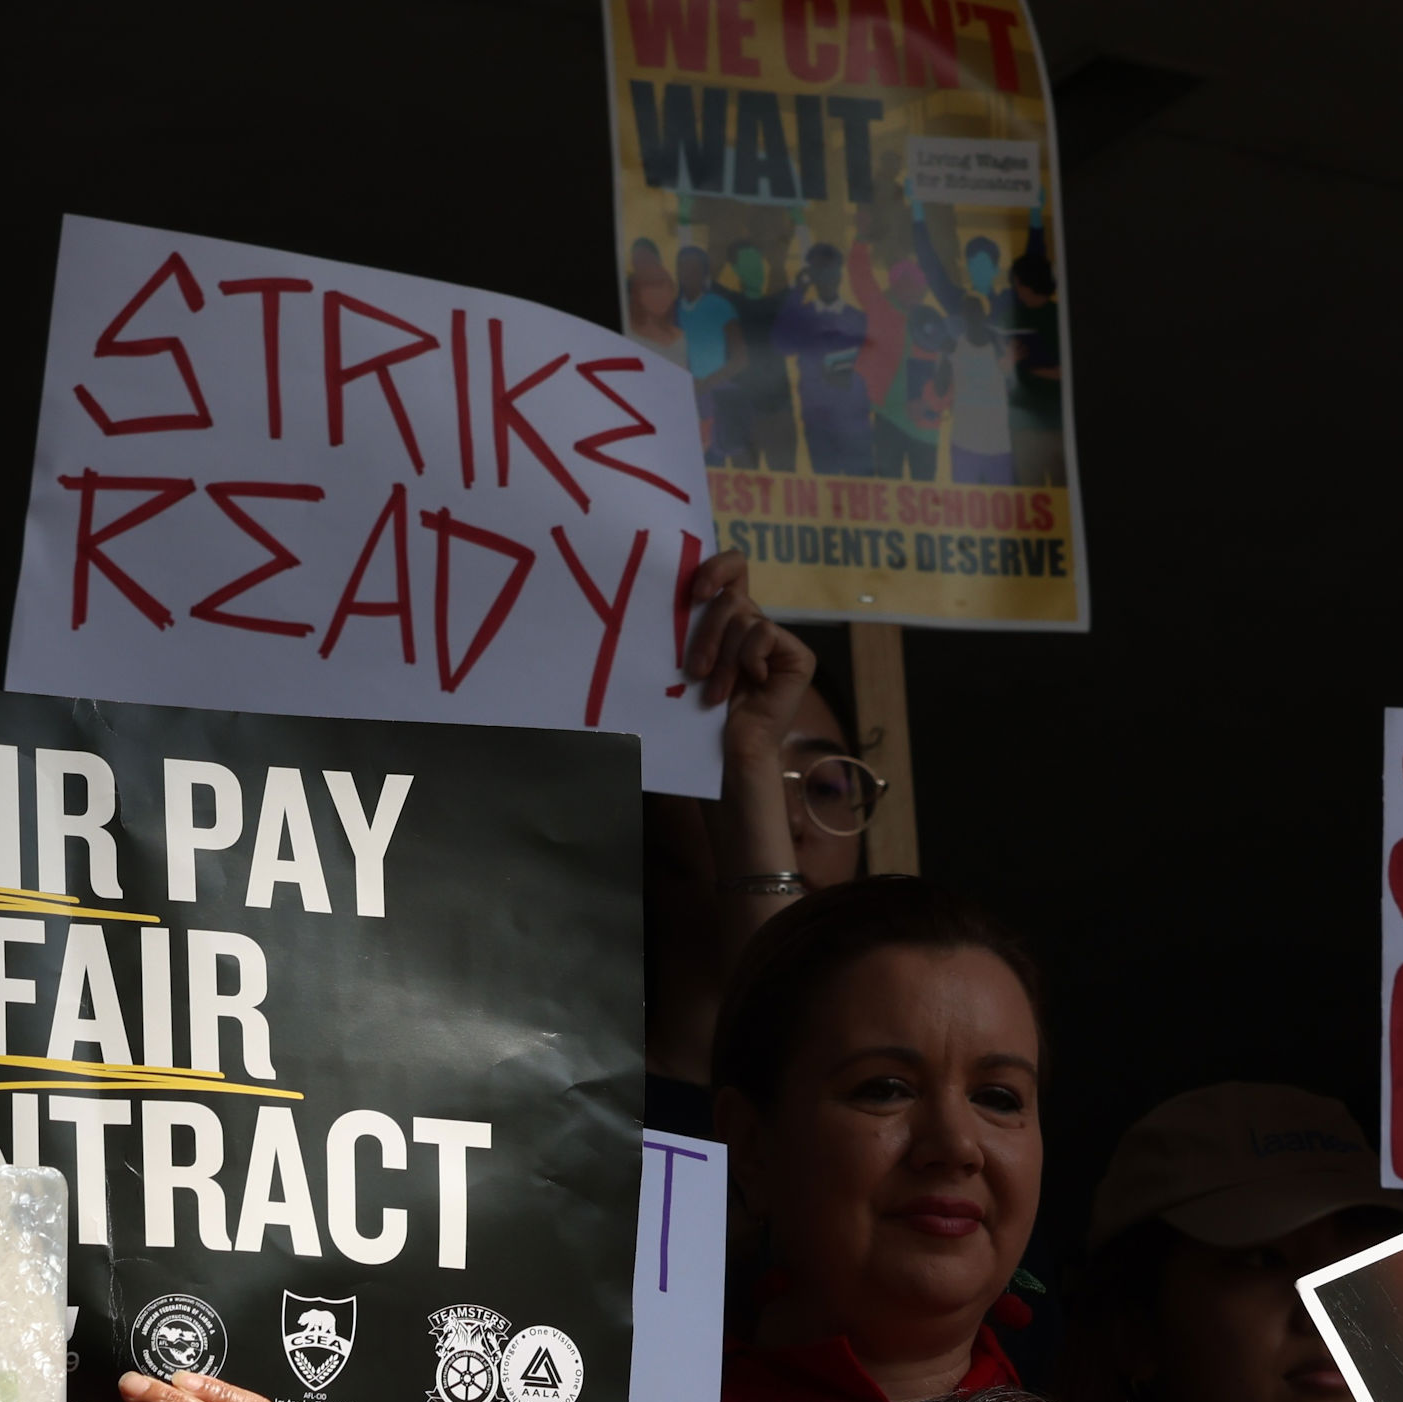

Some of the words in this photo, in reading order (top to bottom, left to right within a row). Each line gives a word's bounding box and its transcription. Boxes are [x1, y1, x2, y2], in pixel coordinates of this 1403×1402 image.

[627, 0, 761, 79] WE
[780, 0, 1023, 93] CAN'T
[630, 79, 884, 204] WAIT
[72, 251, 691, 515] STRIKE
[707, 470, 775, 516] EST
[783, 478, 819, 520] IN
[827, 481, 890, 523] THE
[899, 484, 1055, 533] SCHOOLS
[729, 520, 906, 572] STUDENTS
[915, 533, 1067, 578] DESERVE
[57, 466, 703, 728] READY!
[164, 757, 415, 918] PAY
[291, 1334, 343, 1351] CSEA
[431, 1307, 508, 1331] TEAMSTERS
[529, 1327, 549, 1337] One
[552, 1330, 577, 1357] Vision
[502, 1339, 520, 1383] Stronger
[572, 1369, 583, 1391] One
[303, 1391, 327, 1401] AFL-CIO
[521, 1388, 561, 1400] AALA
